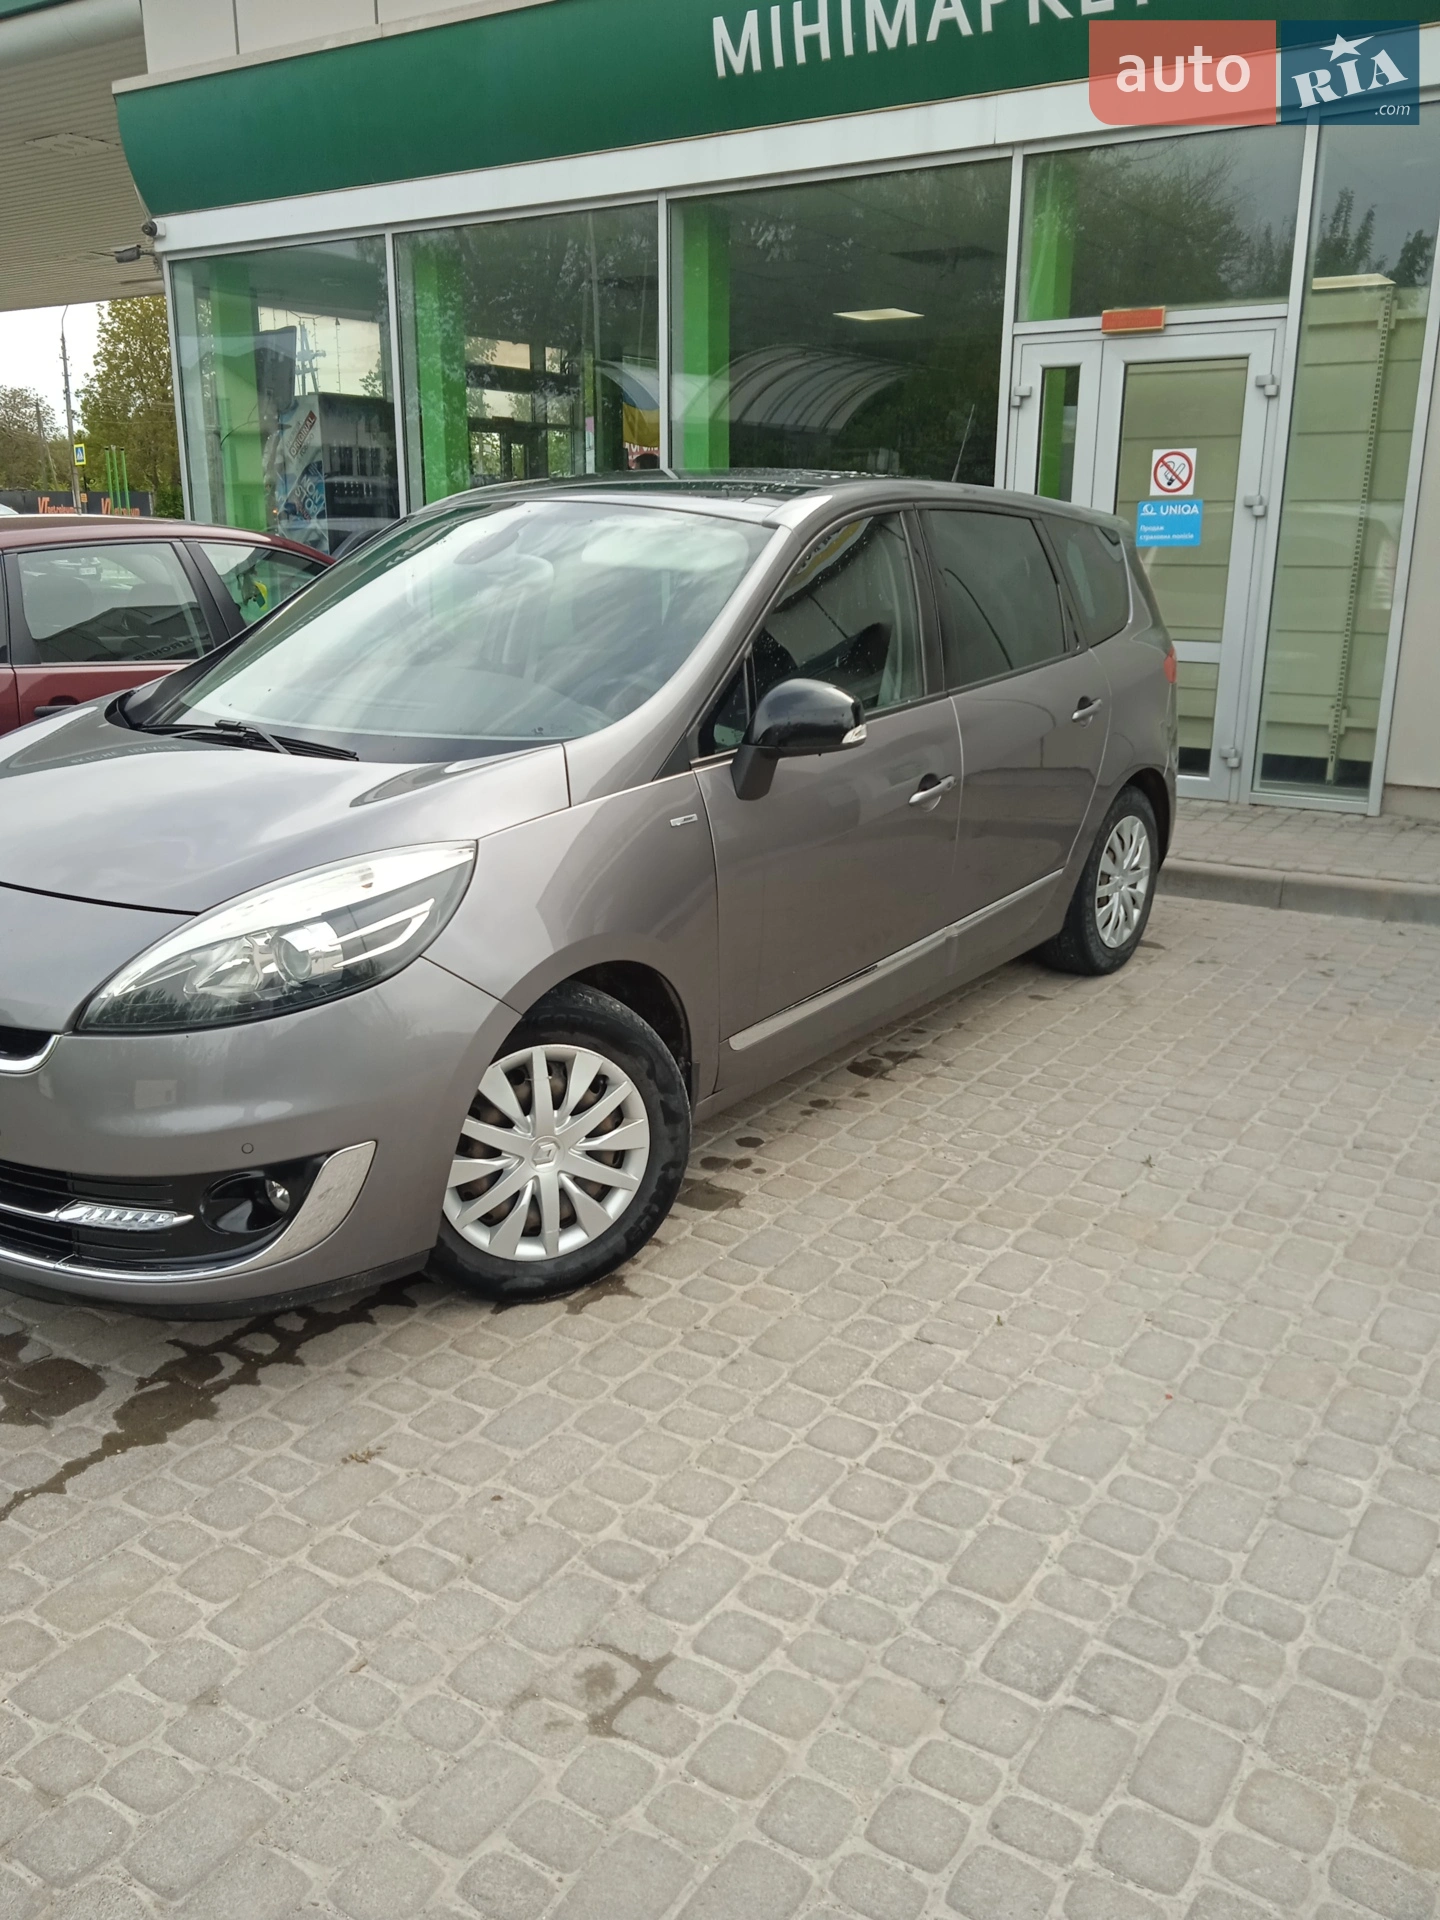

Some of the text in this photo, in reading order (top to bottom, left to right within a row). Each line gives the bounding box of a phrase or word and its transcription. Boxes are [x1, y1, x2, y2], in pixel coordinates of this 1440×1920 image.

[712, 0, 1149, 78] МІНІМА
[290, 417, 316, 456] ORIGINAL
[295, 484, 318, 516] STOP
[301, 474, 321, 503] NON
[1160, 504, 1199, 515] UNIQA
